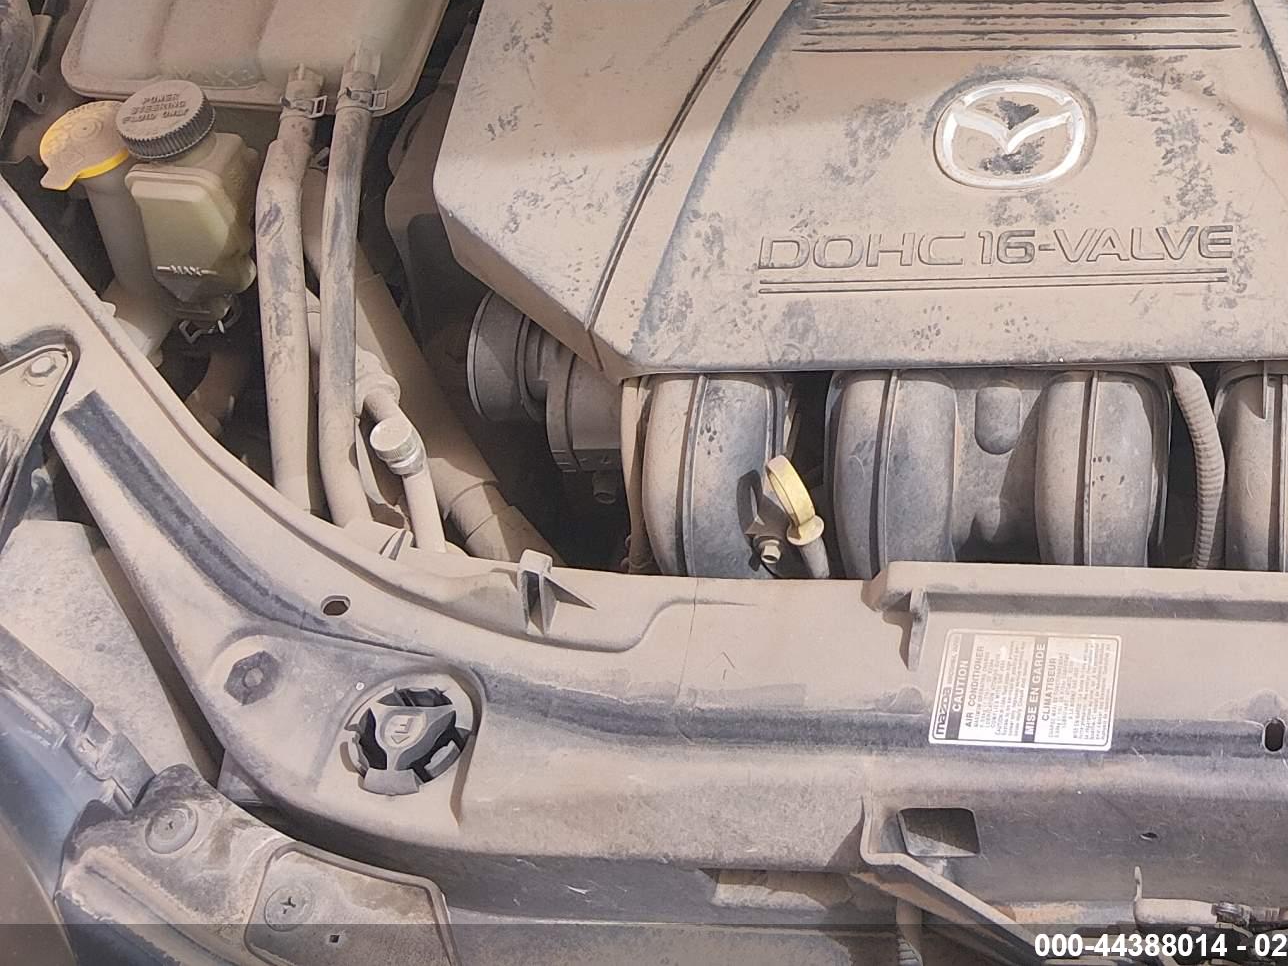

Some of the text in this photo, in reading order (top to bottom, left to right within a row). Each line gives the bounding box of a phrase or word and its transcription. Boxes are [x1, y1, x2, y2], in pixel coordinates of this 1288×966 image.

[757, 224, 1235, 271] DOHC 16-VALVE
[935, 687, 951, 734] mazda
[951, 659, 968, 711] CAUTION
[964, 645, 984, 727] AIR CONDITIONER
[1024, 643, 1045, 735] MISE EN GARDE
[1041, 657, 1056, 721] CLIMATISEUR
